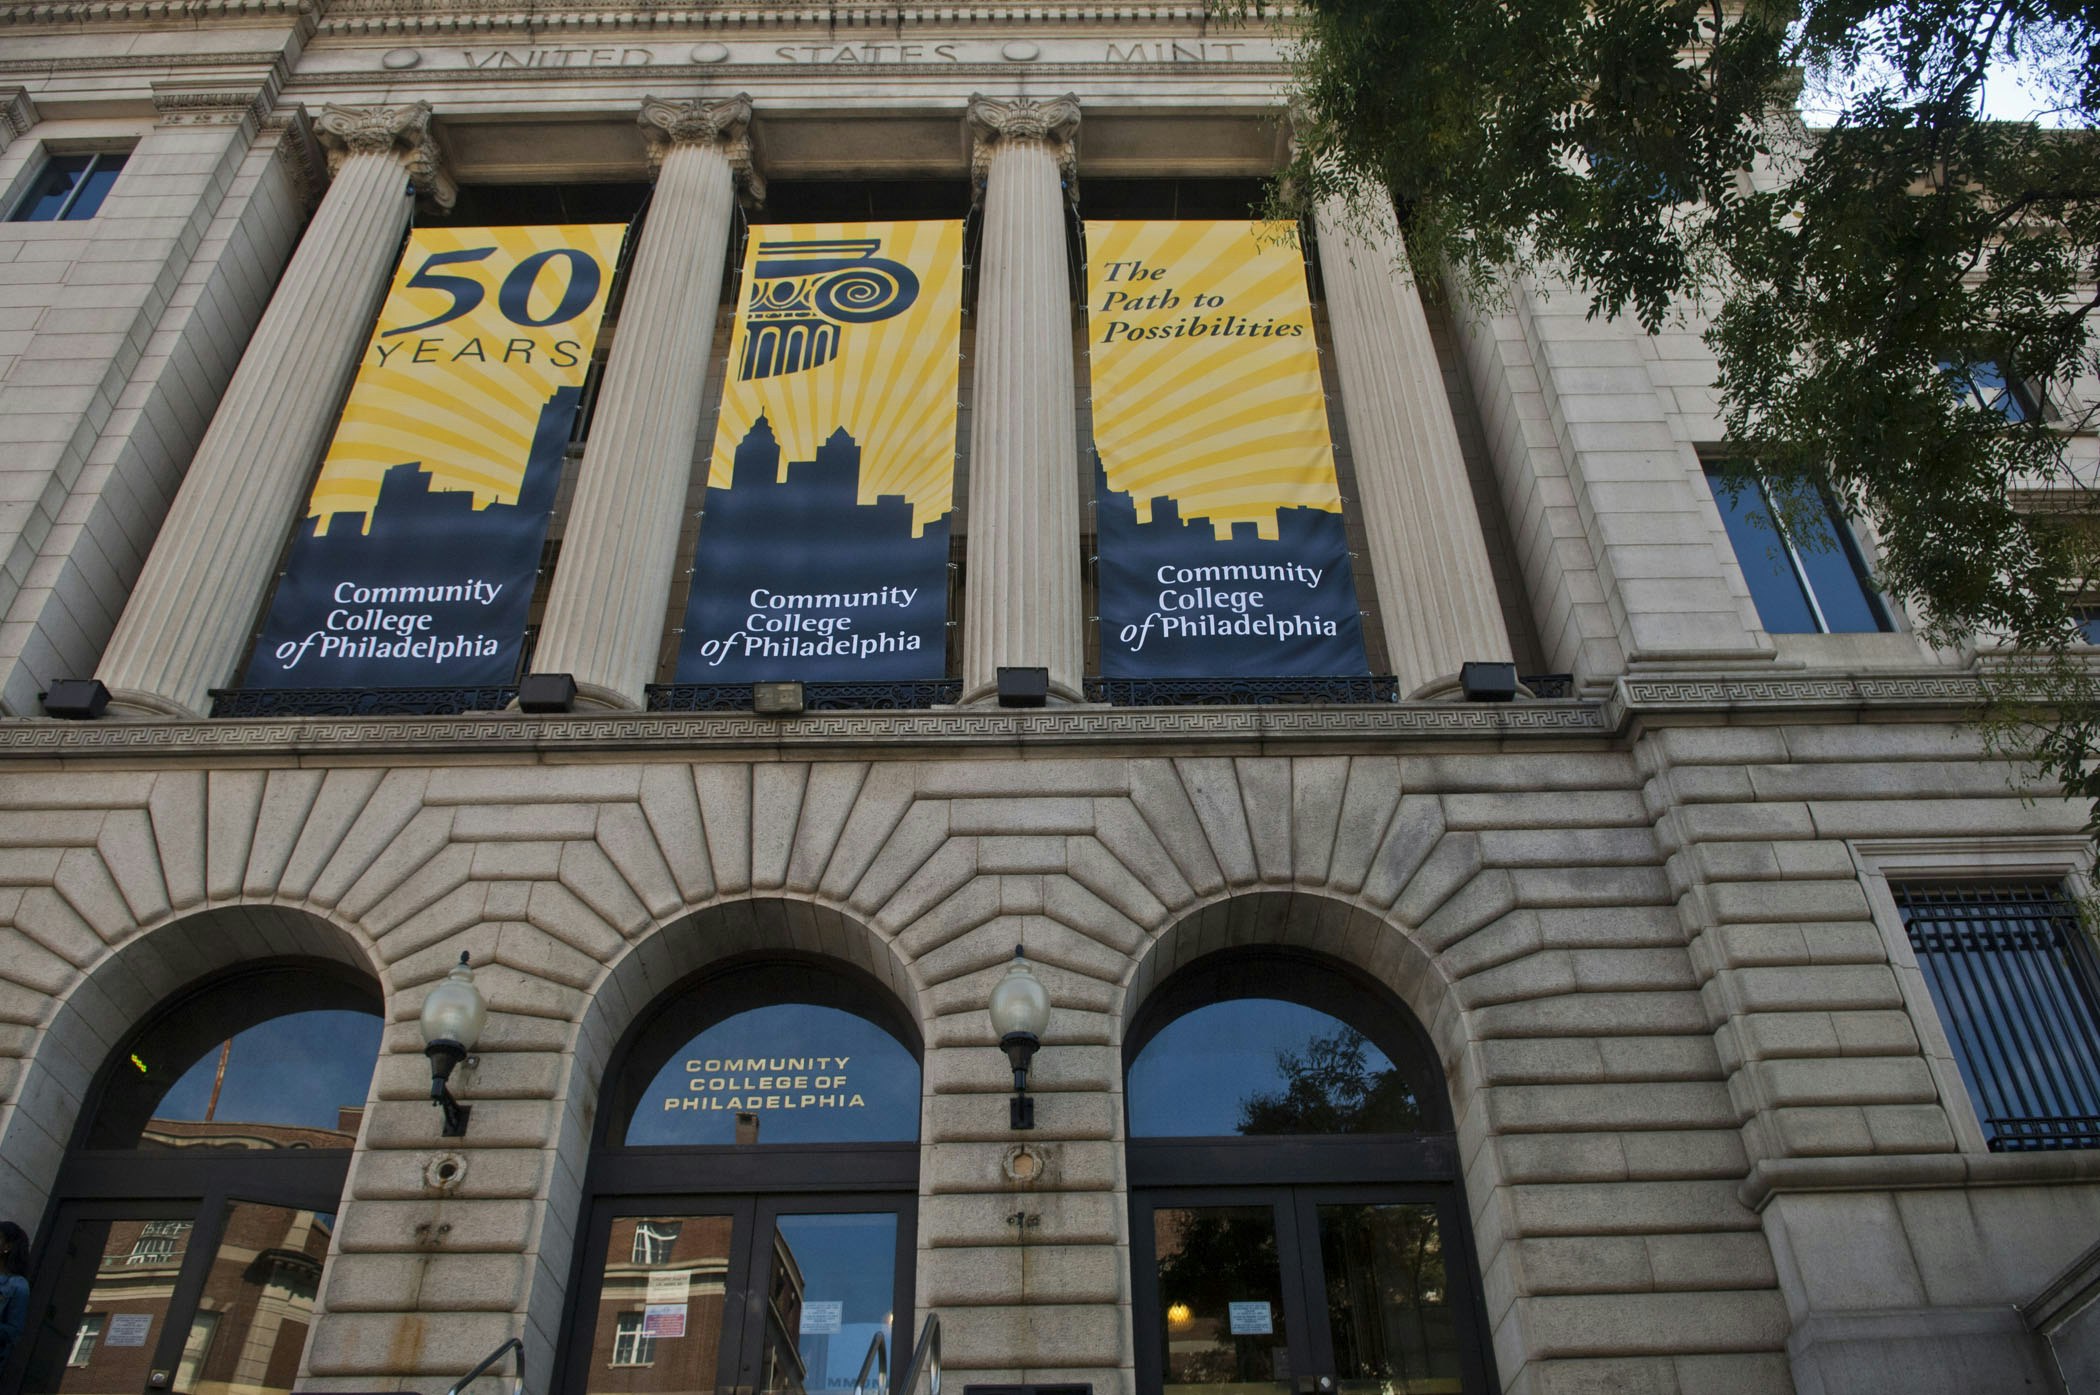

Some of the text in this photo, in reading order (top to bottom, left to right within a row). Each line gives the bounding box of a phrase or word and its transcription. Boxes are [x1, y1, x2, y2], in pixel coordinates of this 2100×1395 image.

[775, 45, 959, 65] STATES
[1106, 43, 1245, 62] MINT
[1104, 260, 1167, 282] The
[381, 246, 601, 338] 50
[1099, 288, 1225, 312] Path to
[1100, 316, 1304, 343] Possibilities
[376, 337, 581, 368] YEARS
[1157, 562, 1323, 588] Community
[333, 579, 503, 605] Community
[750, 586, 918, 608] Community
[1158, 587, 1264, 613] College
[326, 609, 433, 635] College
[746, 613, 851, 636] College
[1119, 612, 1337, 652] of Philadelphia
[275, 630, 499, 670] of Philadelphia
[700, 631, 921, 667] of Philadelphia
[685, 1056, 850, 1073] COMMUNITY
[689, 1075, 847, 1091] COLLEGE OF
[664, 1094, 866, 1112] PHILADELPHIA
